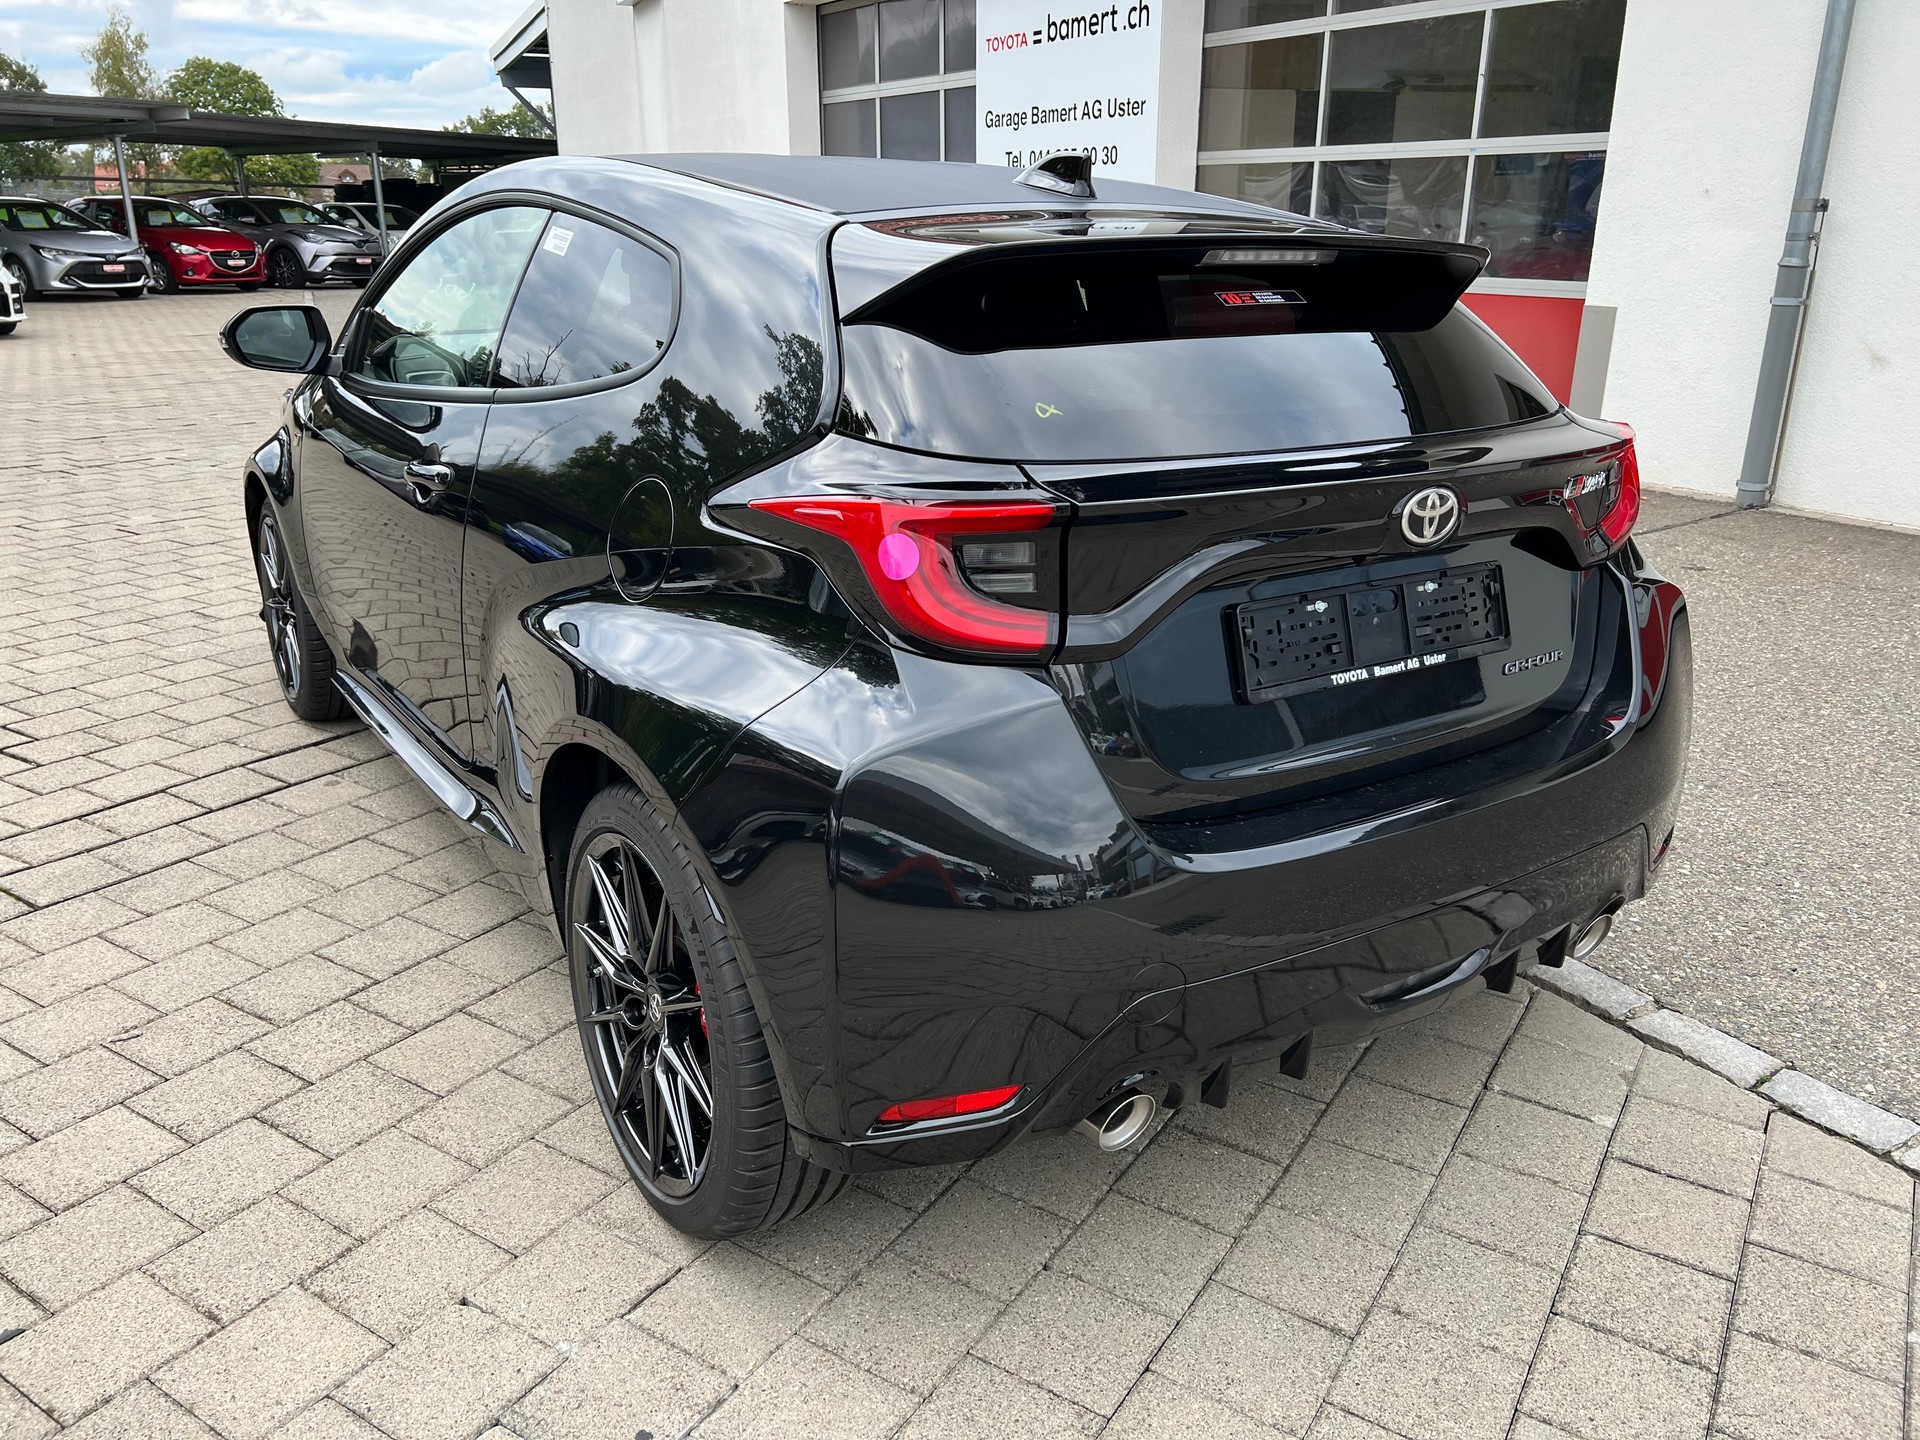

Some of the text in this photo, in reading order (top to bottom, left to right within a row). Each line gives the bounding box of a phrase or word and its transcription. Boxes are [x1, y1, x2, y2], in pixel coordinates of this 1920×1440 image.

[985, 32, 1028, 53] TOYOTA
[985, 98, 1147, 131] Garage Bamert AG Uster
[1005, 150, 1026, 168] Tel.
[1101, 145, 1118, 165] 30
[1221, 293, 1242, 304] 10
[1330, 653, 1447, 686] TOYOTA Bamert AG Uster
